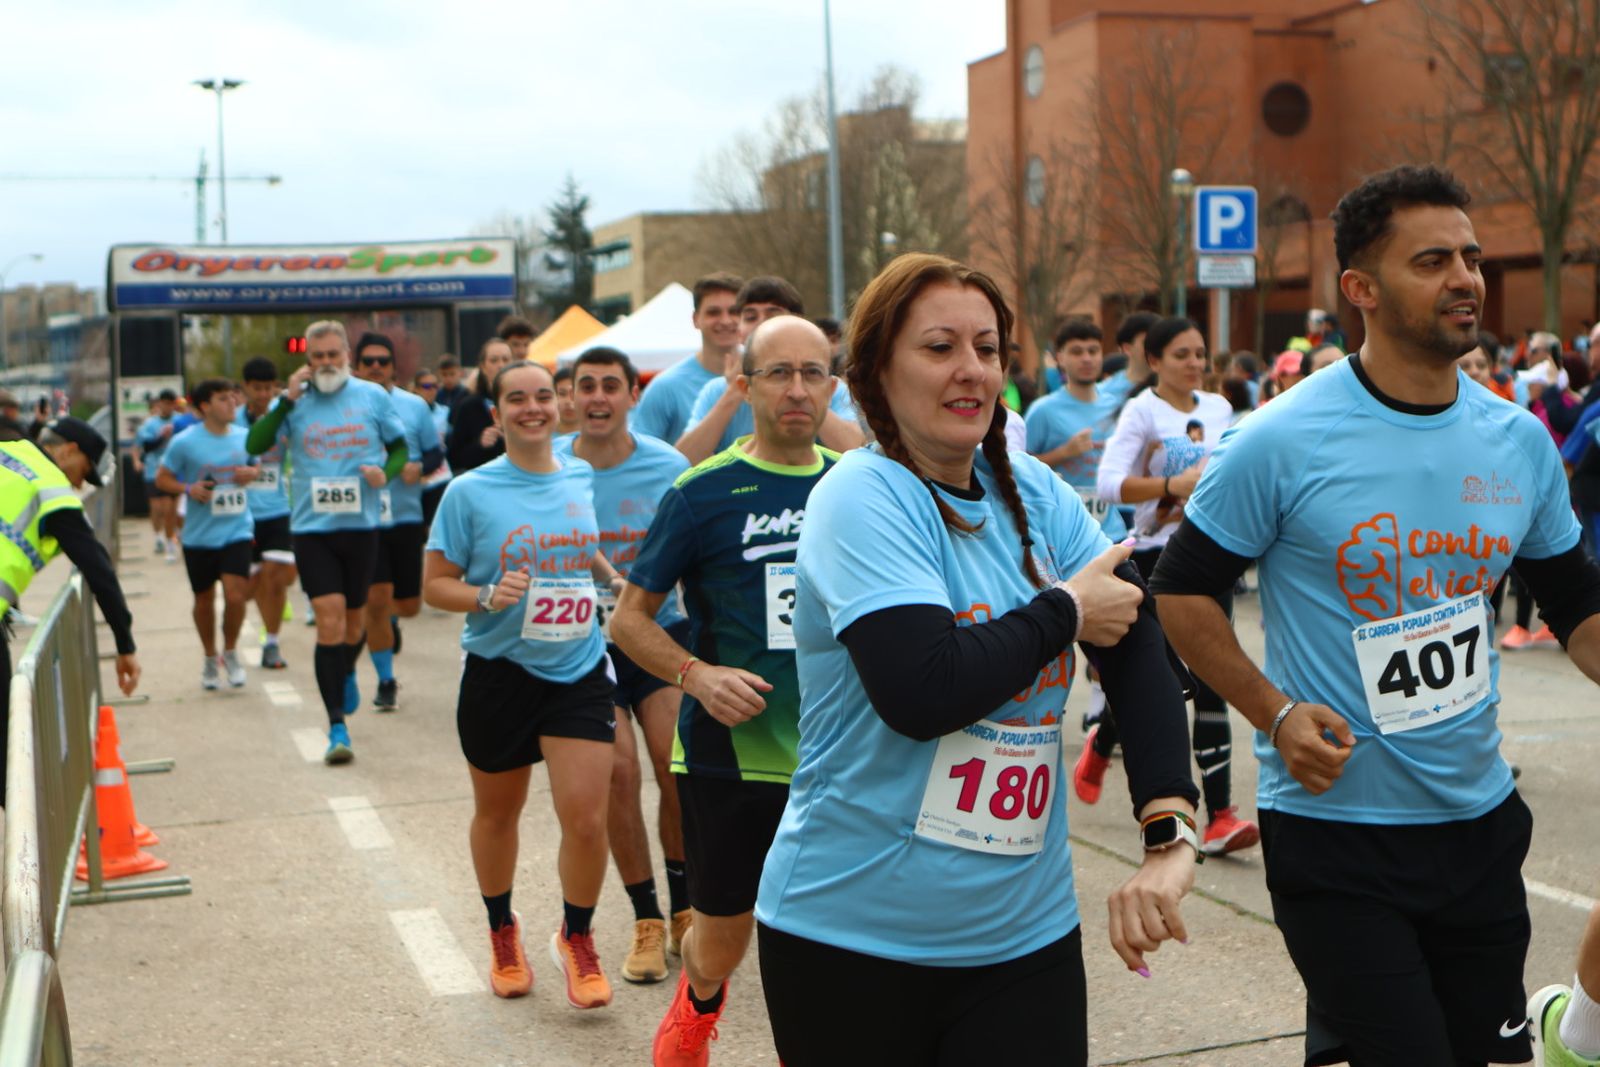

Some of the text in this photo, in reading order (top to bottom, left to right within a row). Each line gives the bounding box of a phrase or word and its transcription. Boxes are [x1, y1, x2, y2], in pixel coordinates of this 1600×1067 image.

[1209, 195, 1245, 246] P
[170, 279, 466, 302] www.orycronsport.com
[318, 487, 356, 504] 285
[540, 528, 598, 550] contra
[1408, 524, 1512, 559] contra
[1409, 567, 1440, 599] el
[532, 596, 593, 625] 220
[1368, 622, 1401, 638] CARRERA
[1402, 614, 1432, 632] POPULAR
[1433, 605, 1456, 622] CONTRA
[1377, 624, 1481, 699] 407
[998, 731, 1027, 746] POPULAR
[949, 757, 1050, 820] 180
